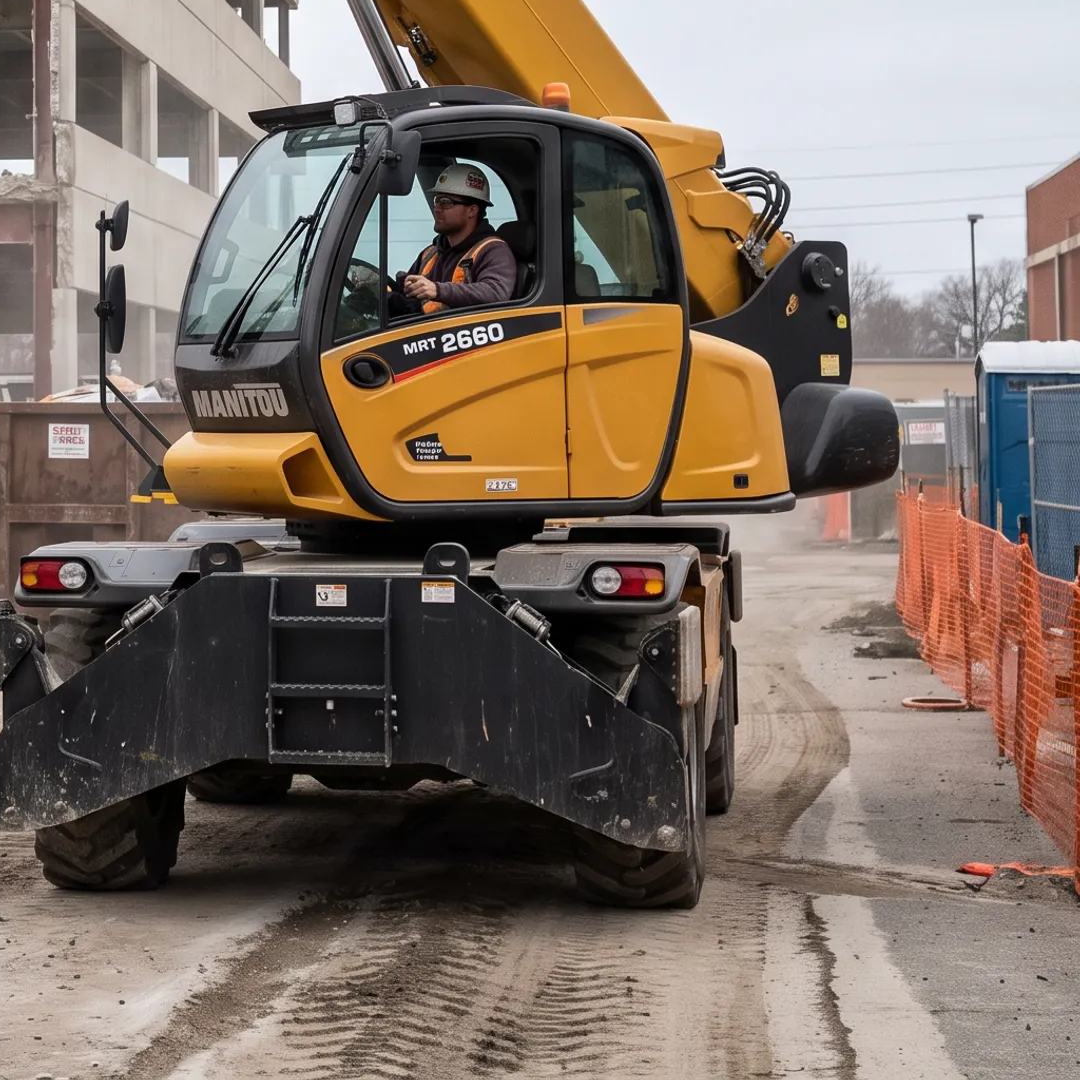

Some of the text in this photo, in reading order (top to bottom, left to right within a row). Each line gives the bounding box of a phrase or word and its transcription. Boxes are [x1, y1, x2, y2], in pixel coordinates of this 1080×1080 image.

[403, 322, 505, 355] MRT 2660
[191, 388, 289, 417] MANITOU
